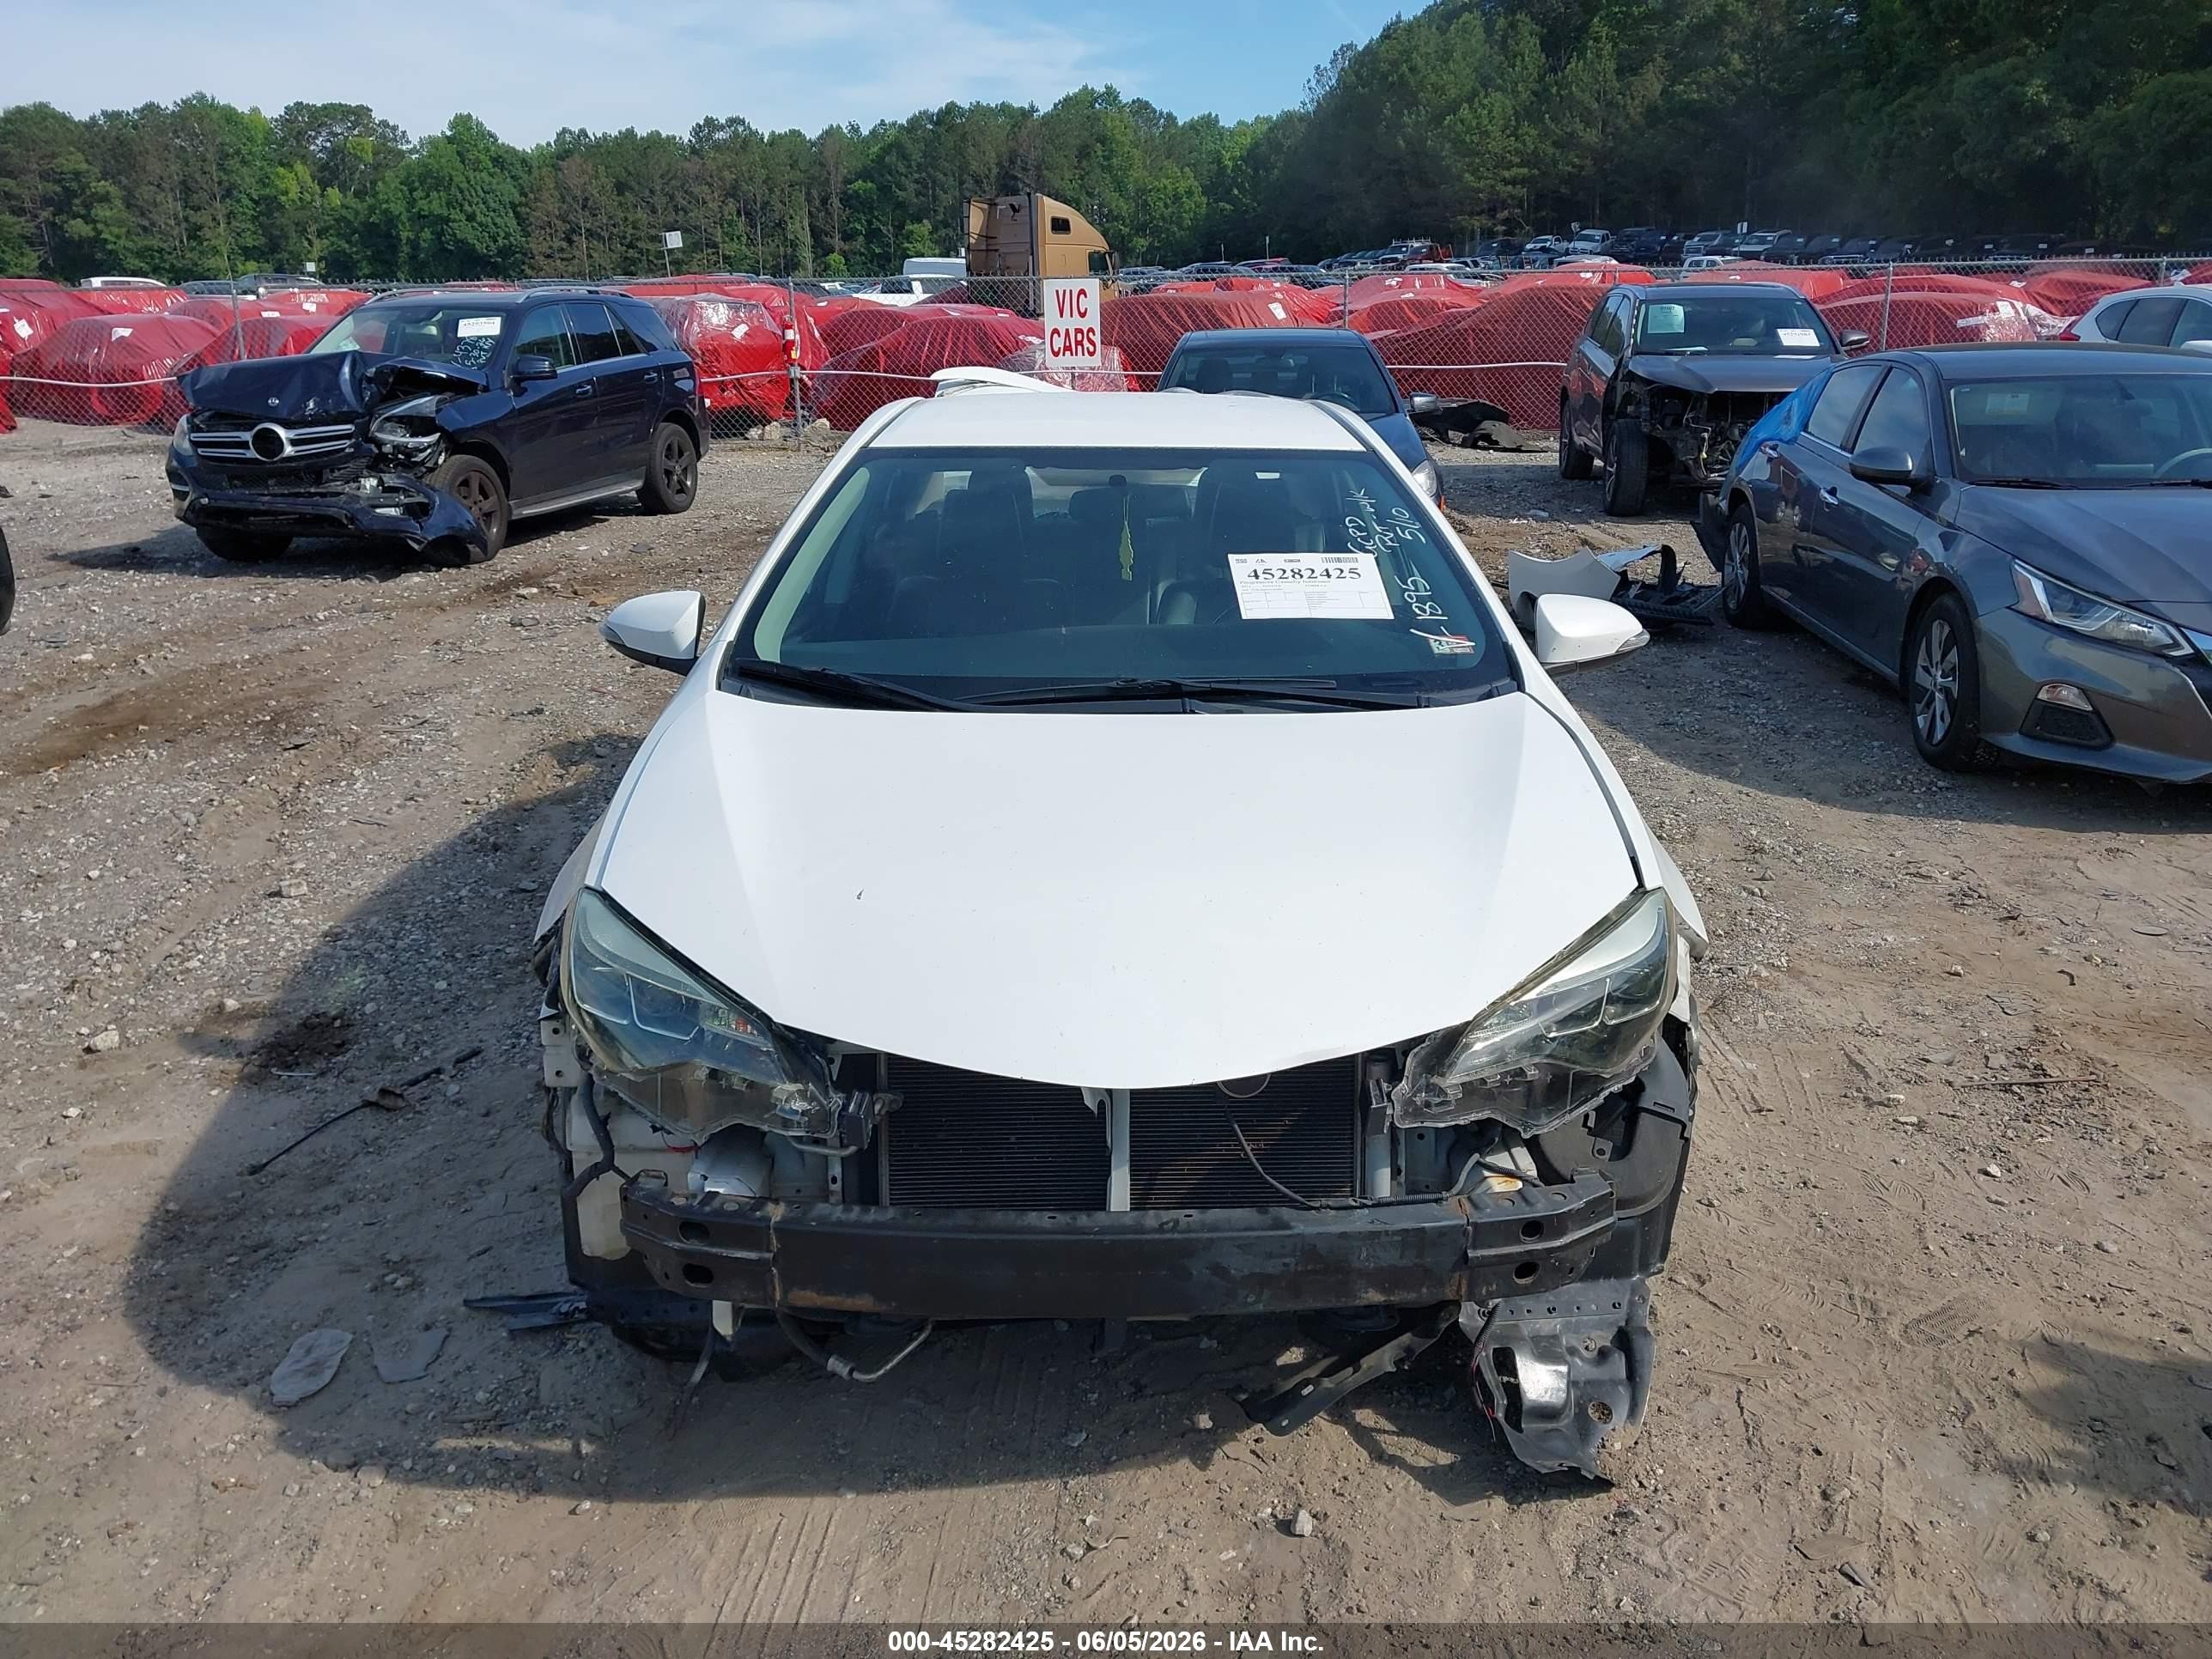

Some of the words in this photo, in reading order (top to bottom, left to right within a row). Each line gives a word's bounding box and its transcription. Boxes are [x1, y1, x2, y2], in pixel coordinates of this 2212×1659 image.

[1054, 288, 1088, 319] VIC
[1049, 326, 1097, 358] CARS
[1247, 567, 1362, 580] 45282425
